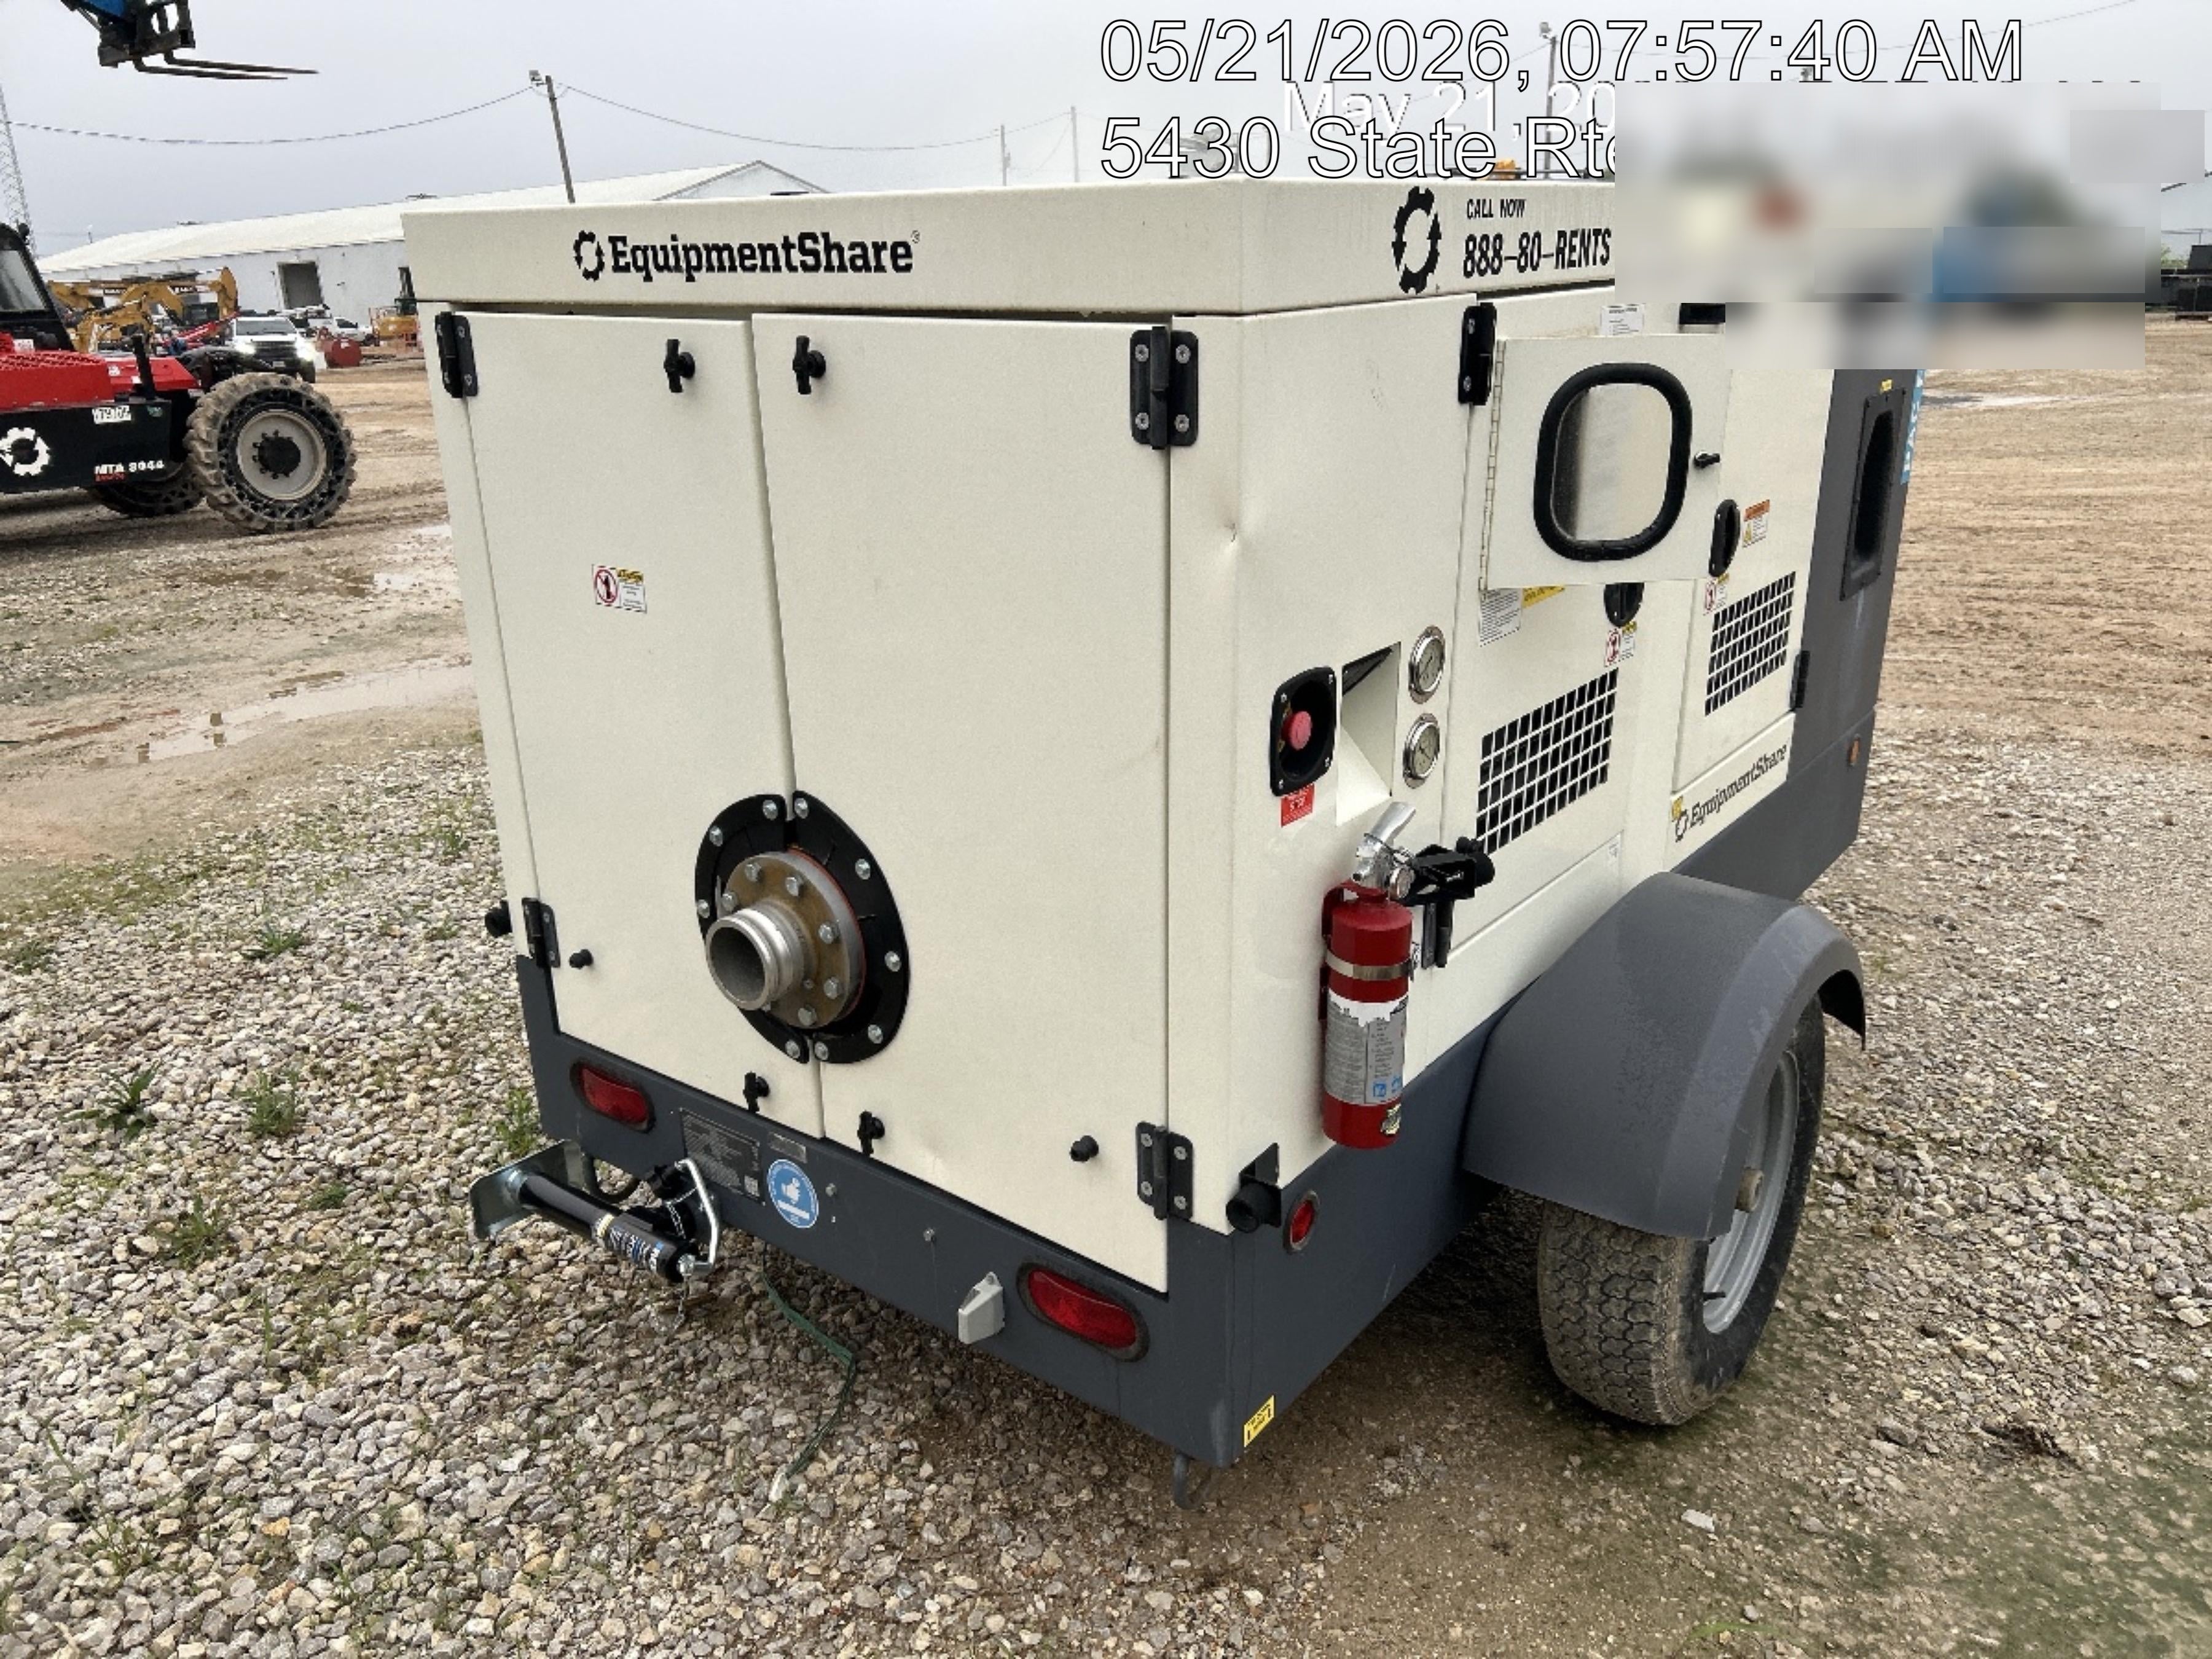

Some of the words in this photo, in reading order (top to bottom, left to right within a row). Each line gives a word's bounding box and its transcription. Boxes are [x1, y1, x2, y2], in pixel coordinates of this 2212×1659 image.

[1467, 198, 1494, 219] CALL
[1500, 198, 1526, 218] NOW
[608, 232, 914, 282] EquipmentShare
[1463, 228, 1612, 278] 888-80-RENTS
[1690, 744, 1787, 828] EquipmentShare
